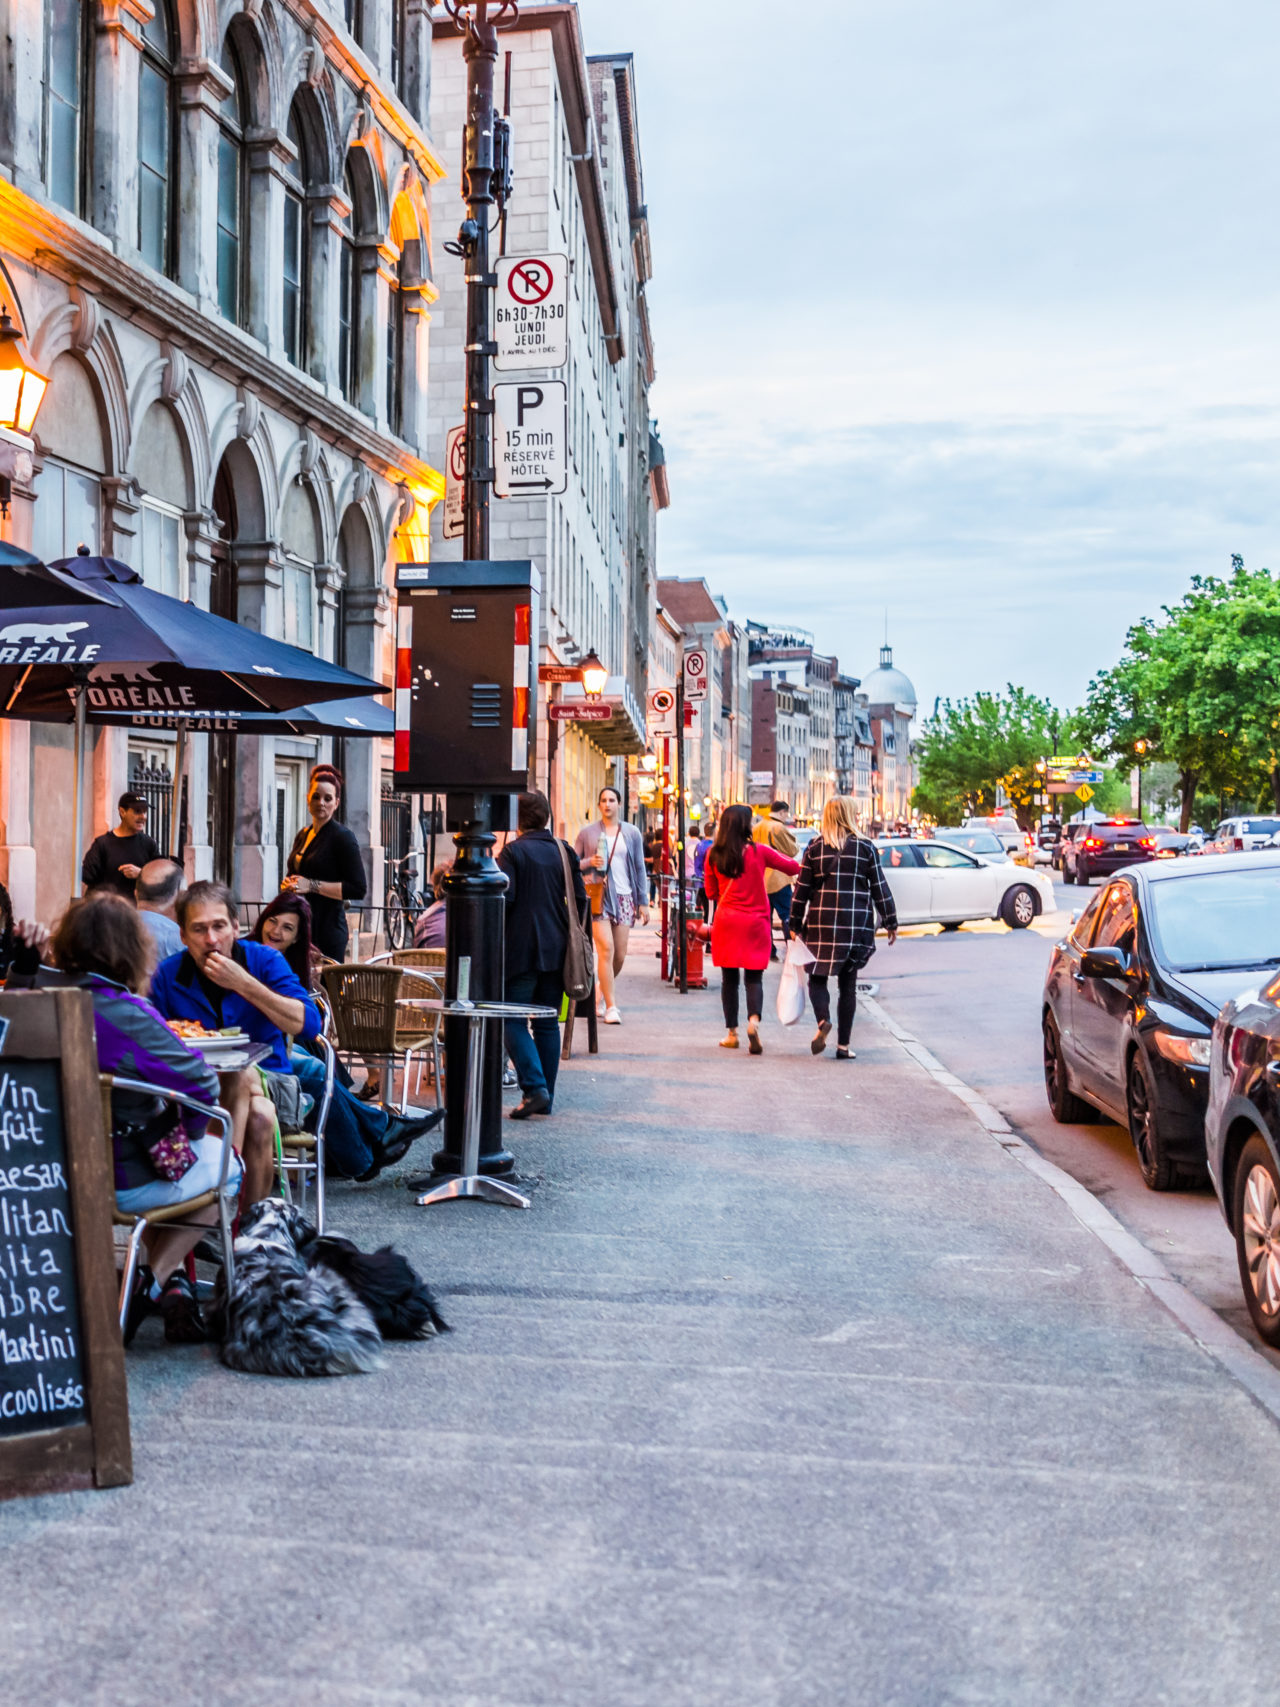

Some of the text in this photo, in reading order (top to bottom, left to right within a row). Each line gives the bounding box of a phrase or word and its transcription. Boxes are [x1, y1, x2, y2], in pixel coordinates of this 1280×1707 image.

[514, 321, 546, 334] LUNDI
[514, 334, 546, 346] JEUDI
[517, 387, 544, 427] P
[506, 428, 553, 447] 15 min
[503, 447, 556, 462] RÉSERVÉ
[511, 463, 548, 475] HÔTEL
